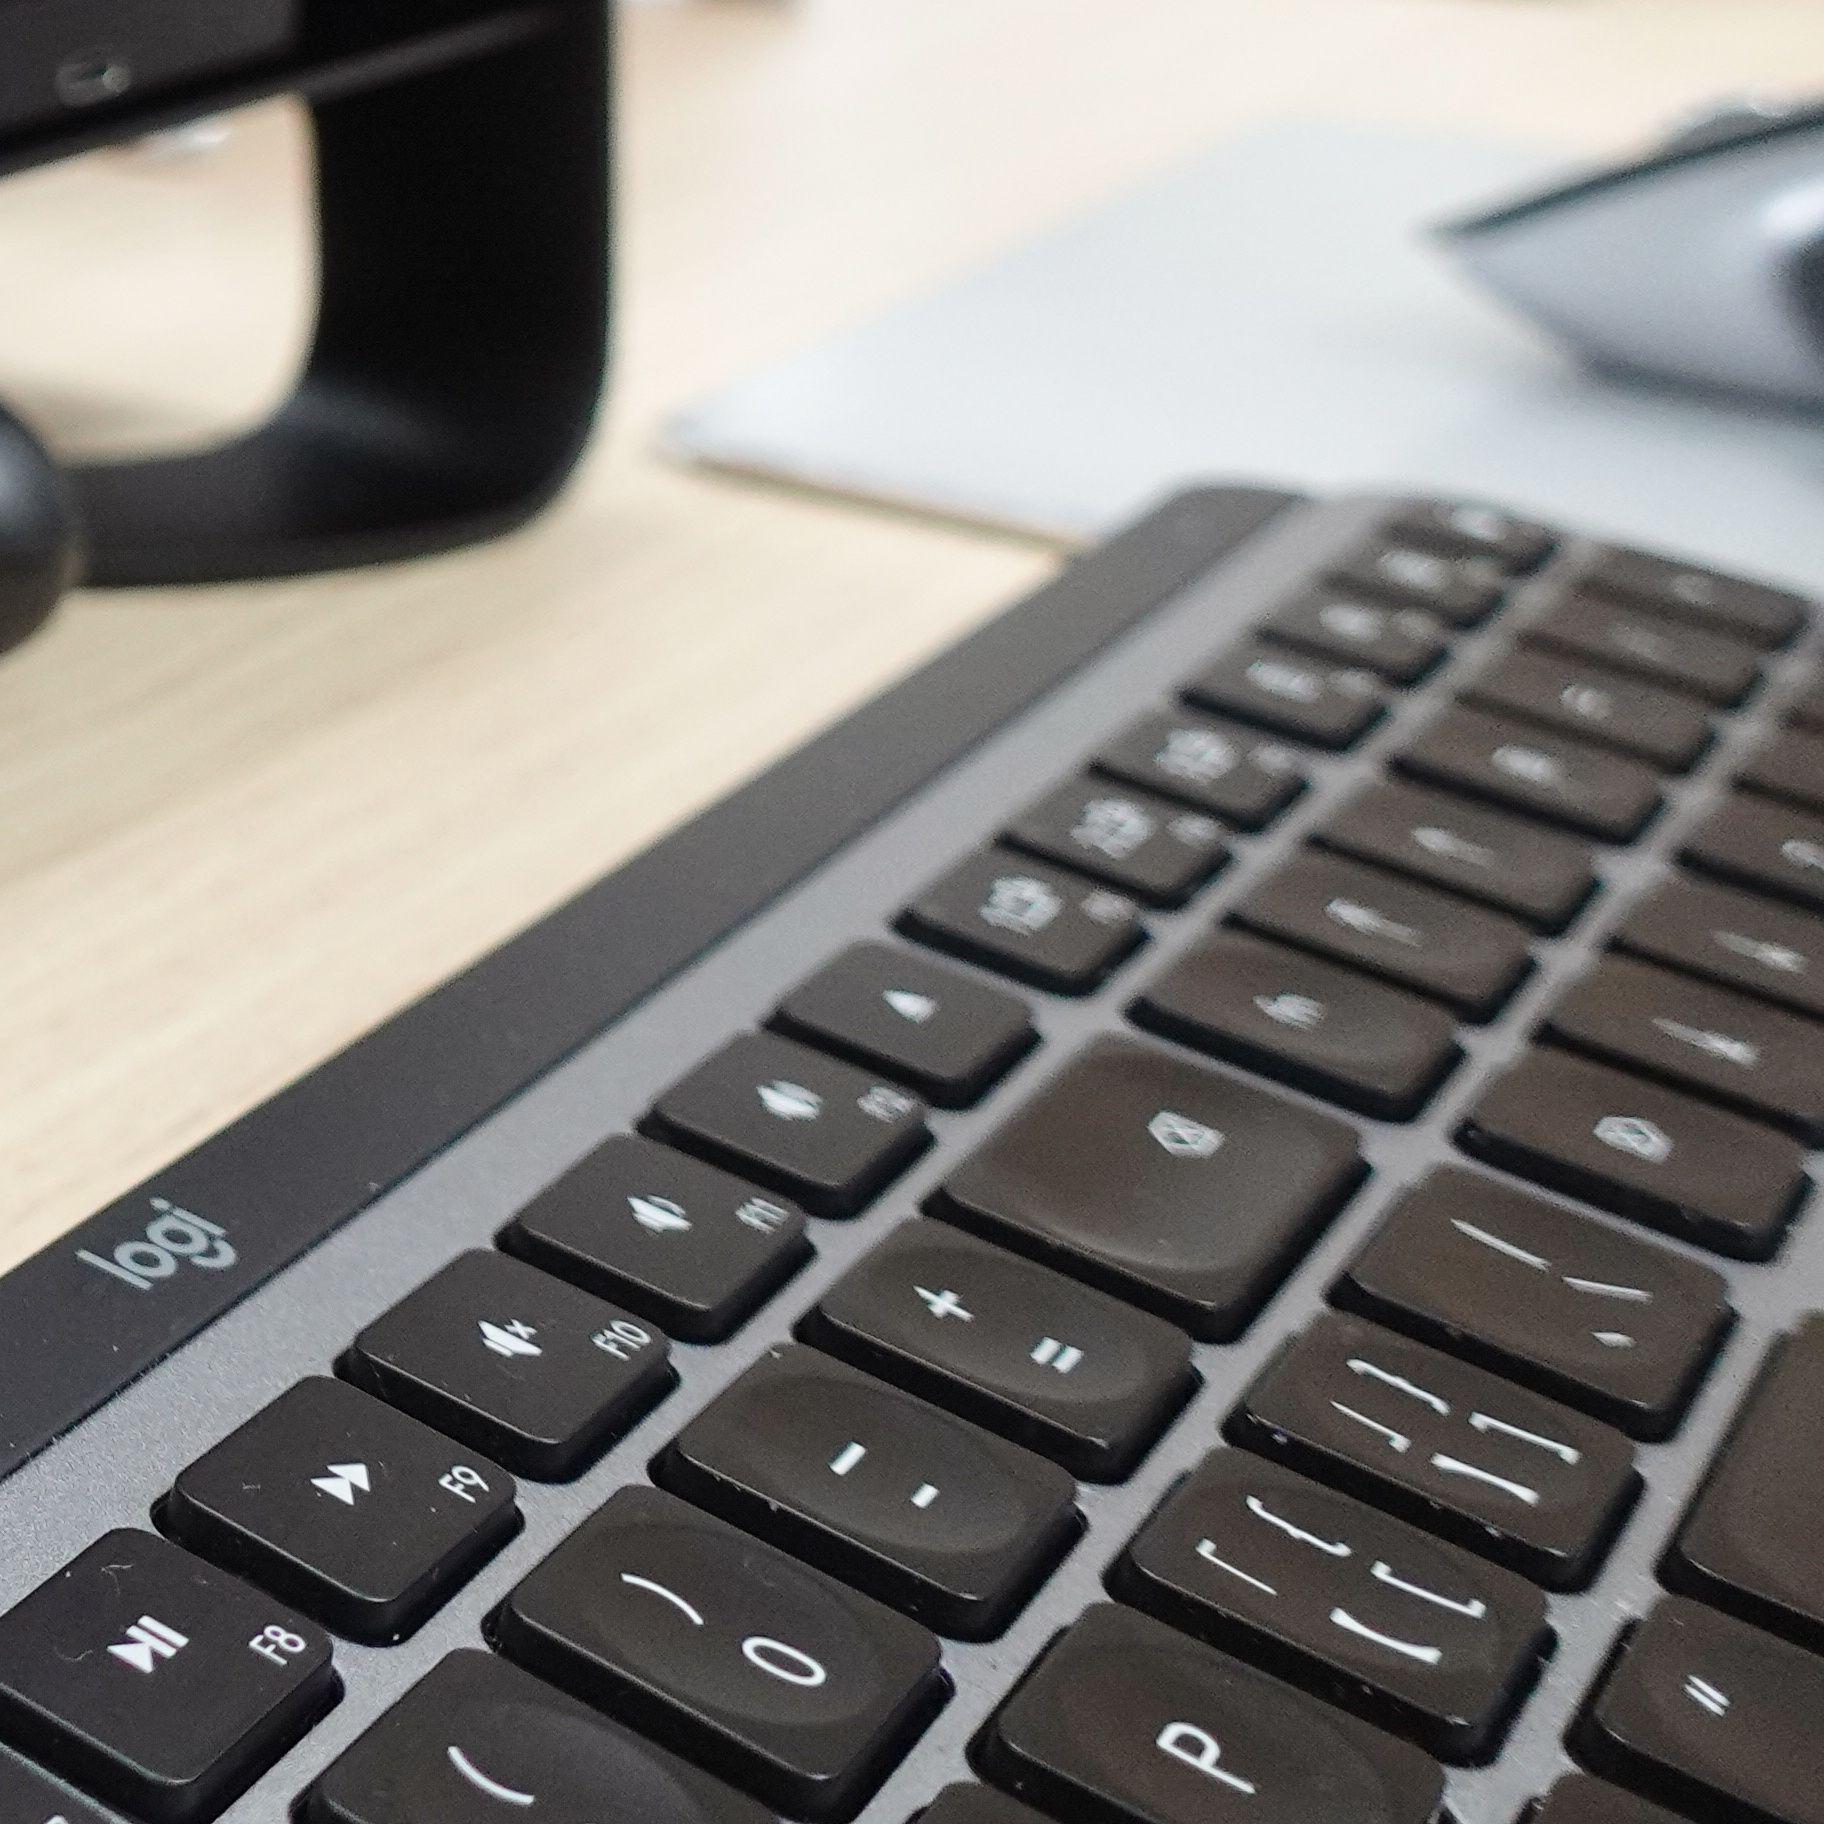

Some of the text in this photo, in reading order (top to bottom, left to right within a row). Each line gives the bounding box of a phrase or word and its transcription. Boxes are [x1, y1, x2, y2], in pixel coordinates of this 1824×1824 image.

[74, 1195, 238, 1292] logi
[590, 1318, 652, 1362] F10
[438, 1464, 490, 1504] F9
[248, 1622, 306, 1666] F8
[1155, 1720, 1257, 1794] P
